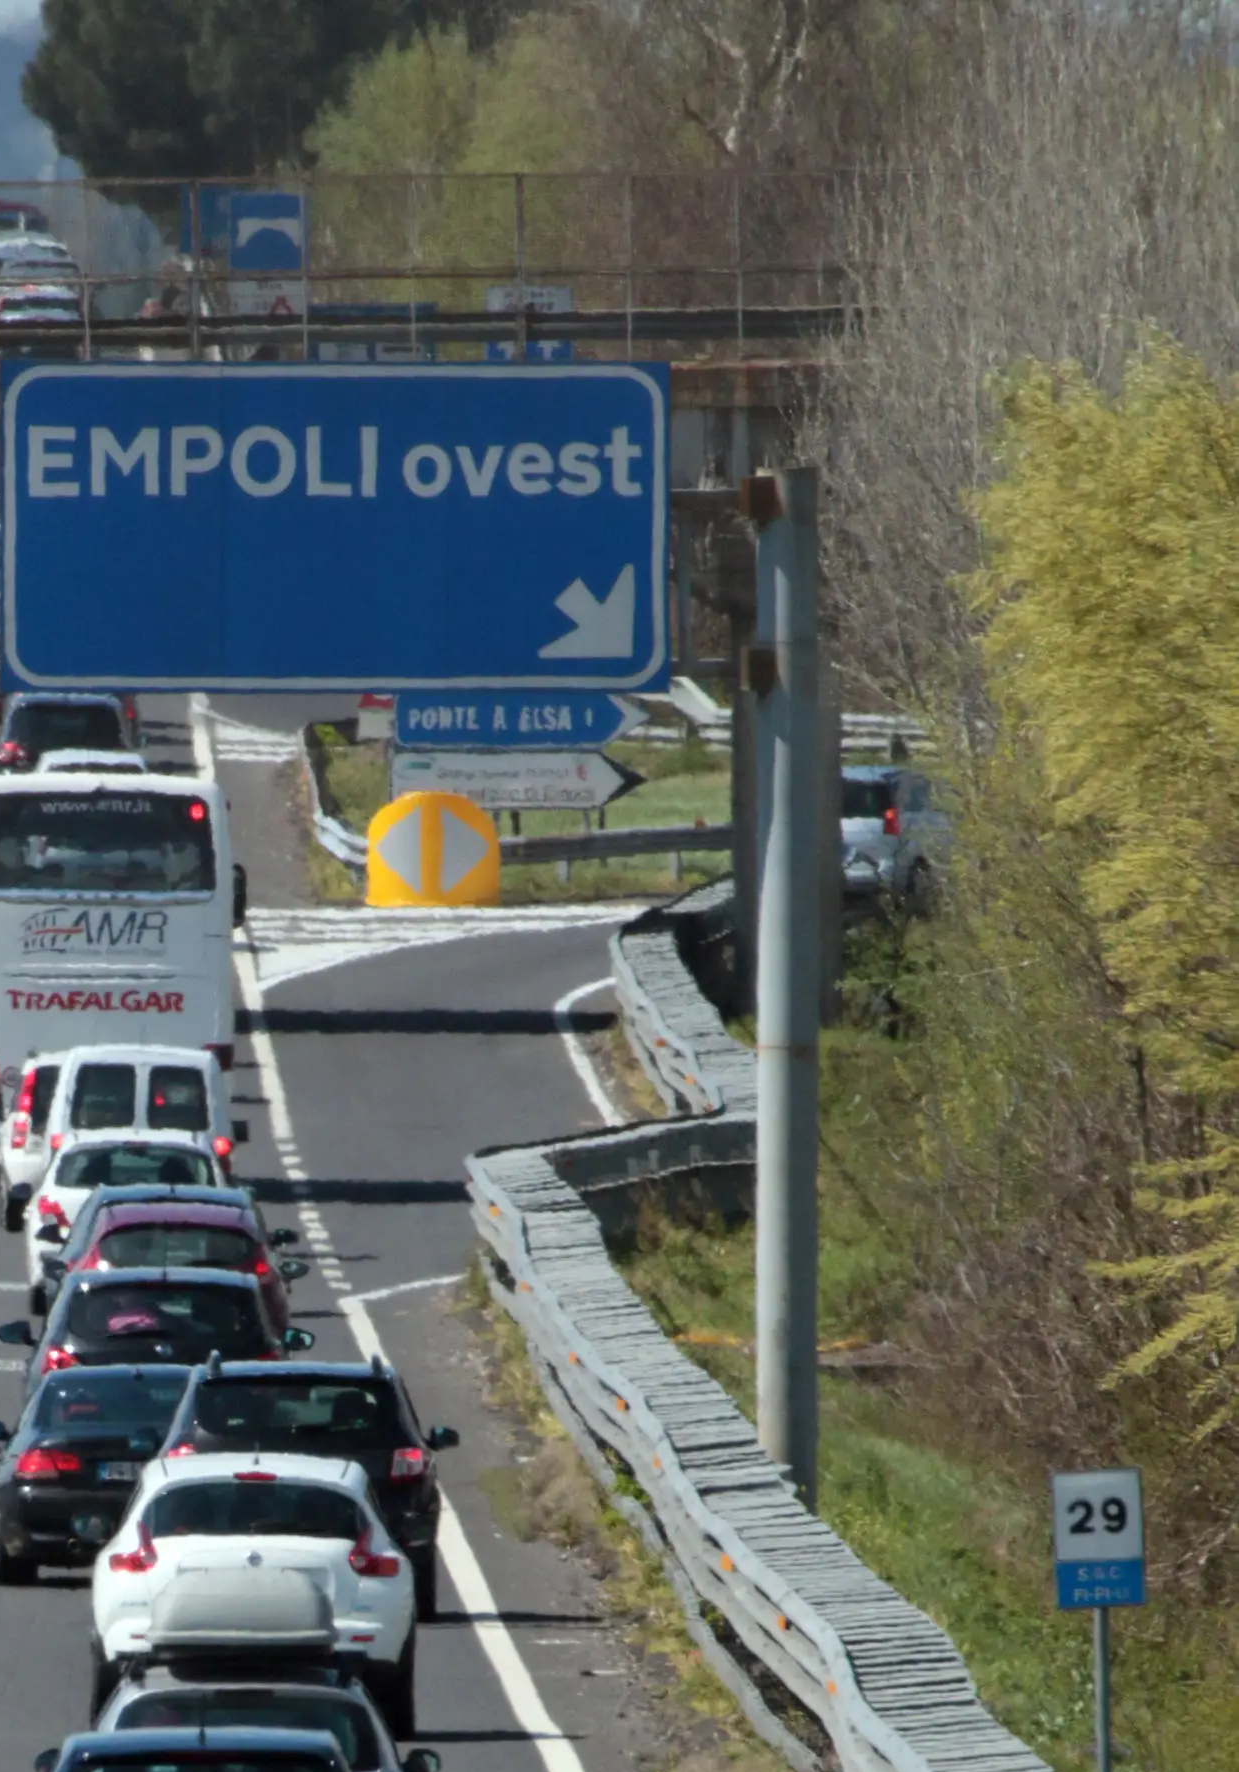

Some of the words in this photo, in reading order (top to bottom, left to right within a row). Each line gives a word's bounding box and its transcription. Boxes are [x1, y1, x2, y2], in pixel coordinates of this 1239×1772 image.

[26, 425, 378, 498] EMPOLI
[401, 425, 643, 498] ovest
[408, 705, 480, 731] PONTE
[492, 704, 507, 731] A
[518, 704, 573, 732] ELSA
[65, 909, 169, 946] AMR
[5, 989, 185, 1013] TRAFALGAR
[1065, 1496, 1128, 1535] 29
